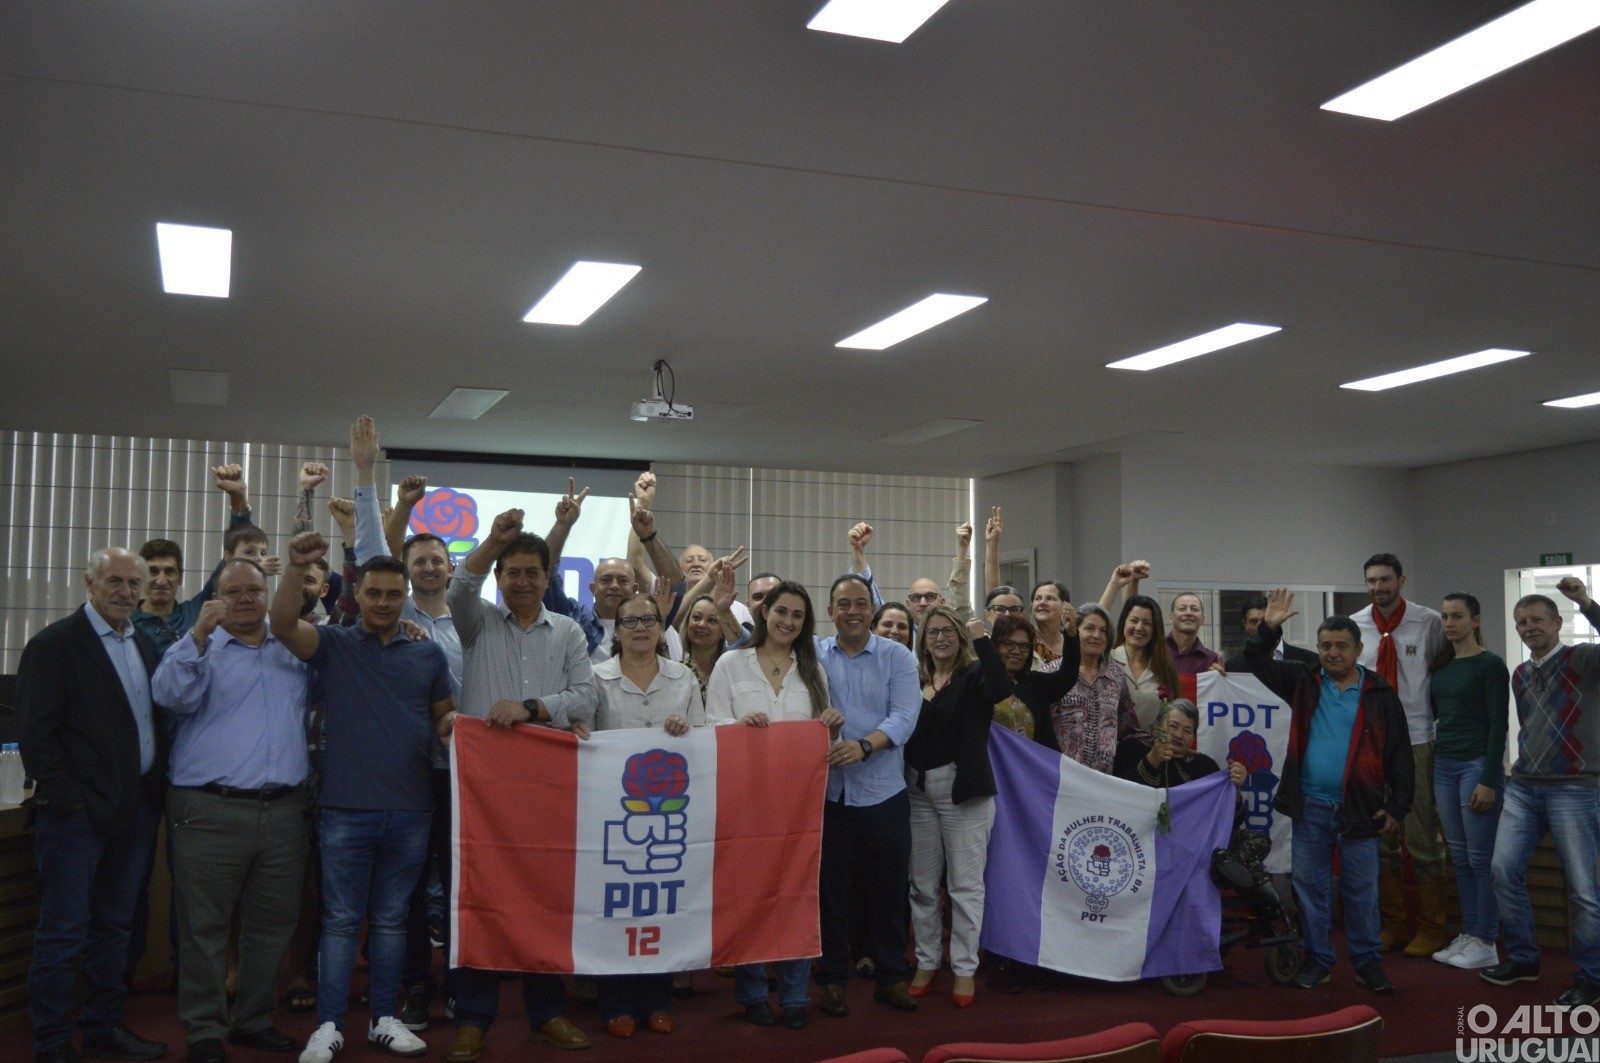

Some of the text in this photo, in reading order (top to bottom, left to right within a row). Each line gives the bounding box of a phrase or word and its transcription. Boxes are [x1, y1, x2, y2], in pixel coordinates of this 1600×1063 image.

[1207, 701, 1280, 729] PDT
[1064, 815, 1105, 836] MULHER
[1059, 837, 1067, 851] DA
[1107, 817, 1146, 871] TRABALHISTA
[1055, 854, 1069, 882] AÇÃO
[603, 880, 685, 918] PDT
[1130, 878, 1143, 894] BR
[1081, 911, 1107, 923] PDT
[625, 926, 660, 957] 12
